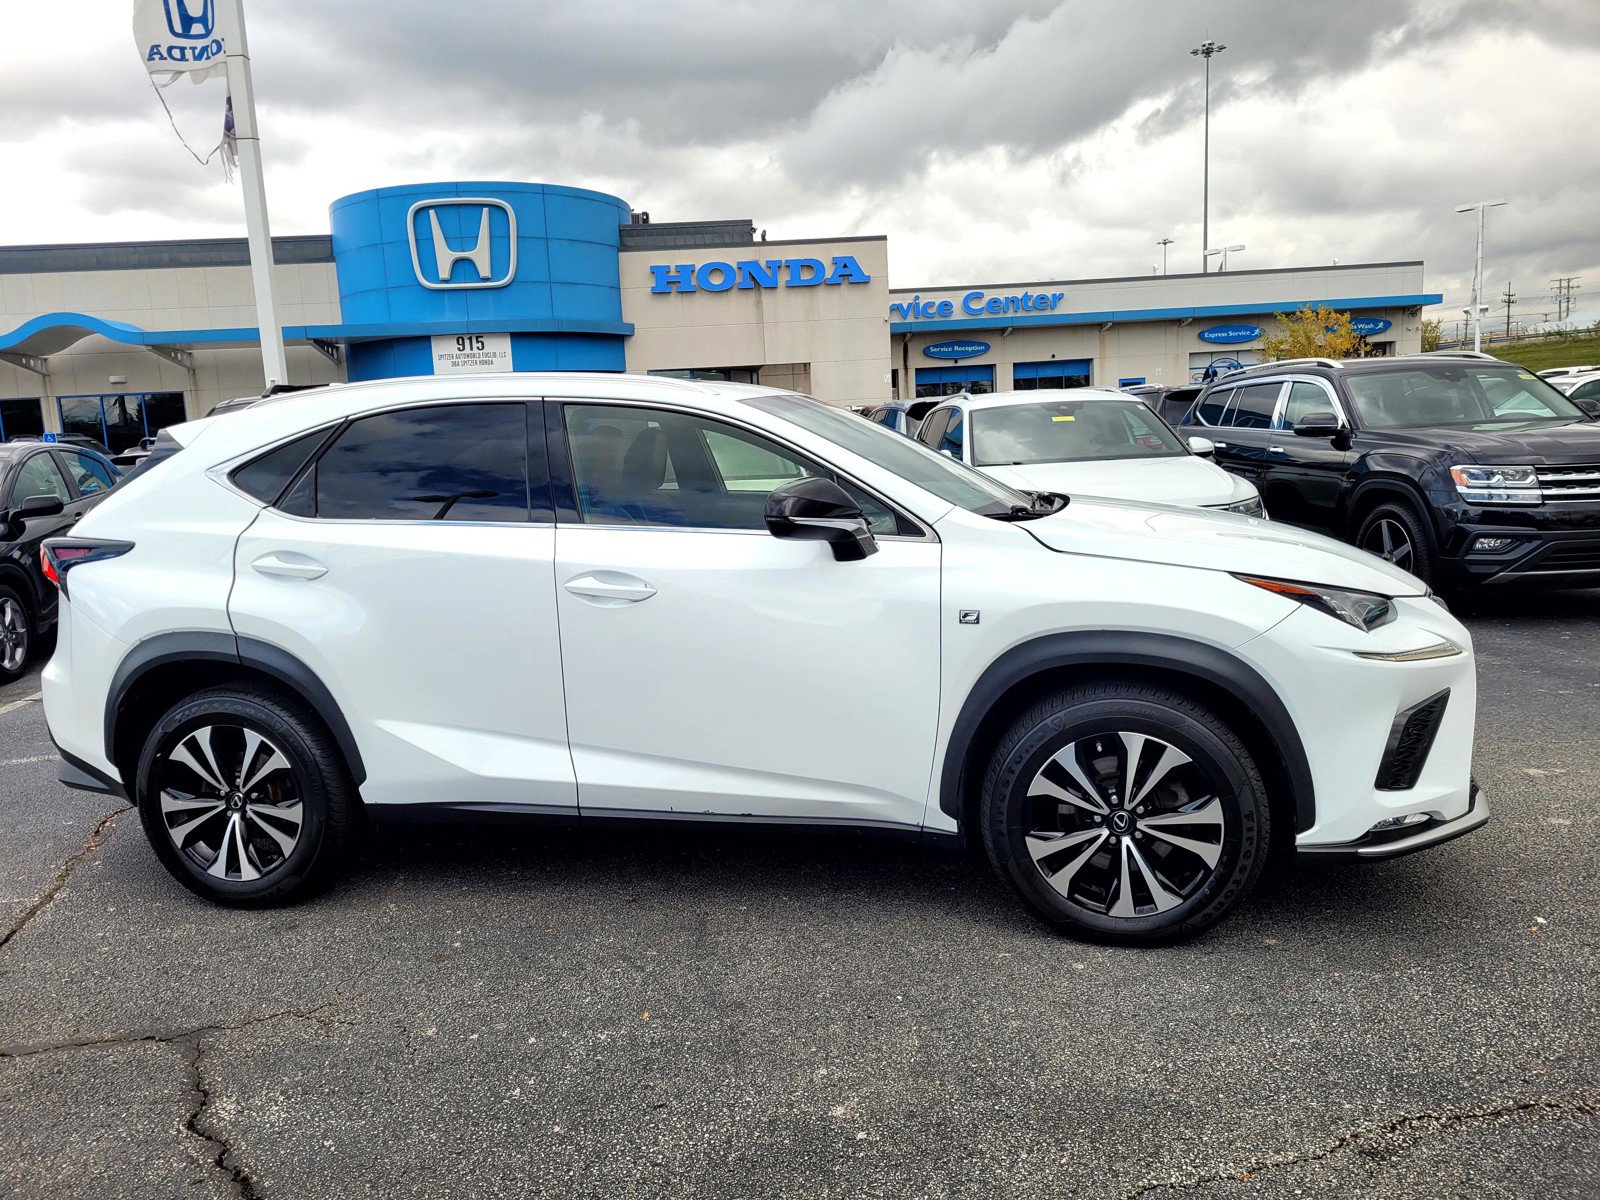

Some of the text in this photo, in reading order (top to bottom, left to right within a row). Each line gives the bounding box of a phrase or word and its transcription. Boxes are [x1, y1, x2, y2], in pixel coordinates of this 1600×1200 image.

[650, 255, 872, 293] HONDA
[889, 290, 1065, 319] rvice Center
[456, 335, 485, 352] 915
[954, 344, 985, 352] Reception
[437, 353, 455, 361] SPITZER
[455, 352, 481, 360] AUTOWORLD
[1200, 810, 1256, 921] Firestone
